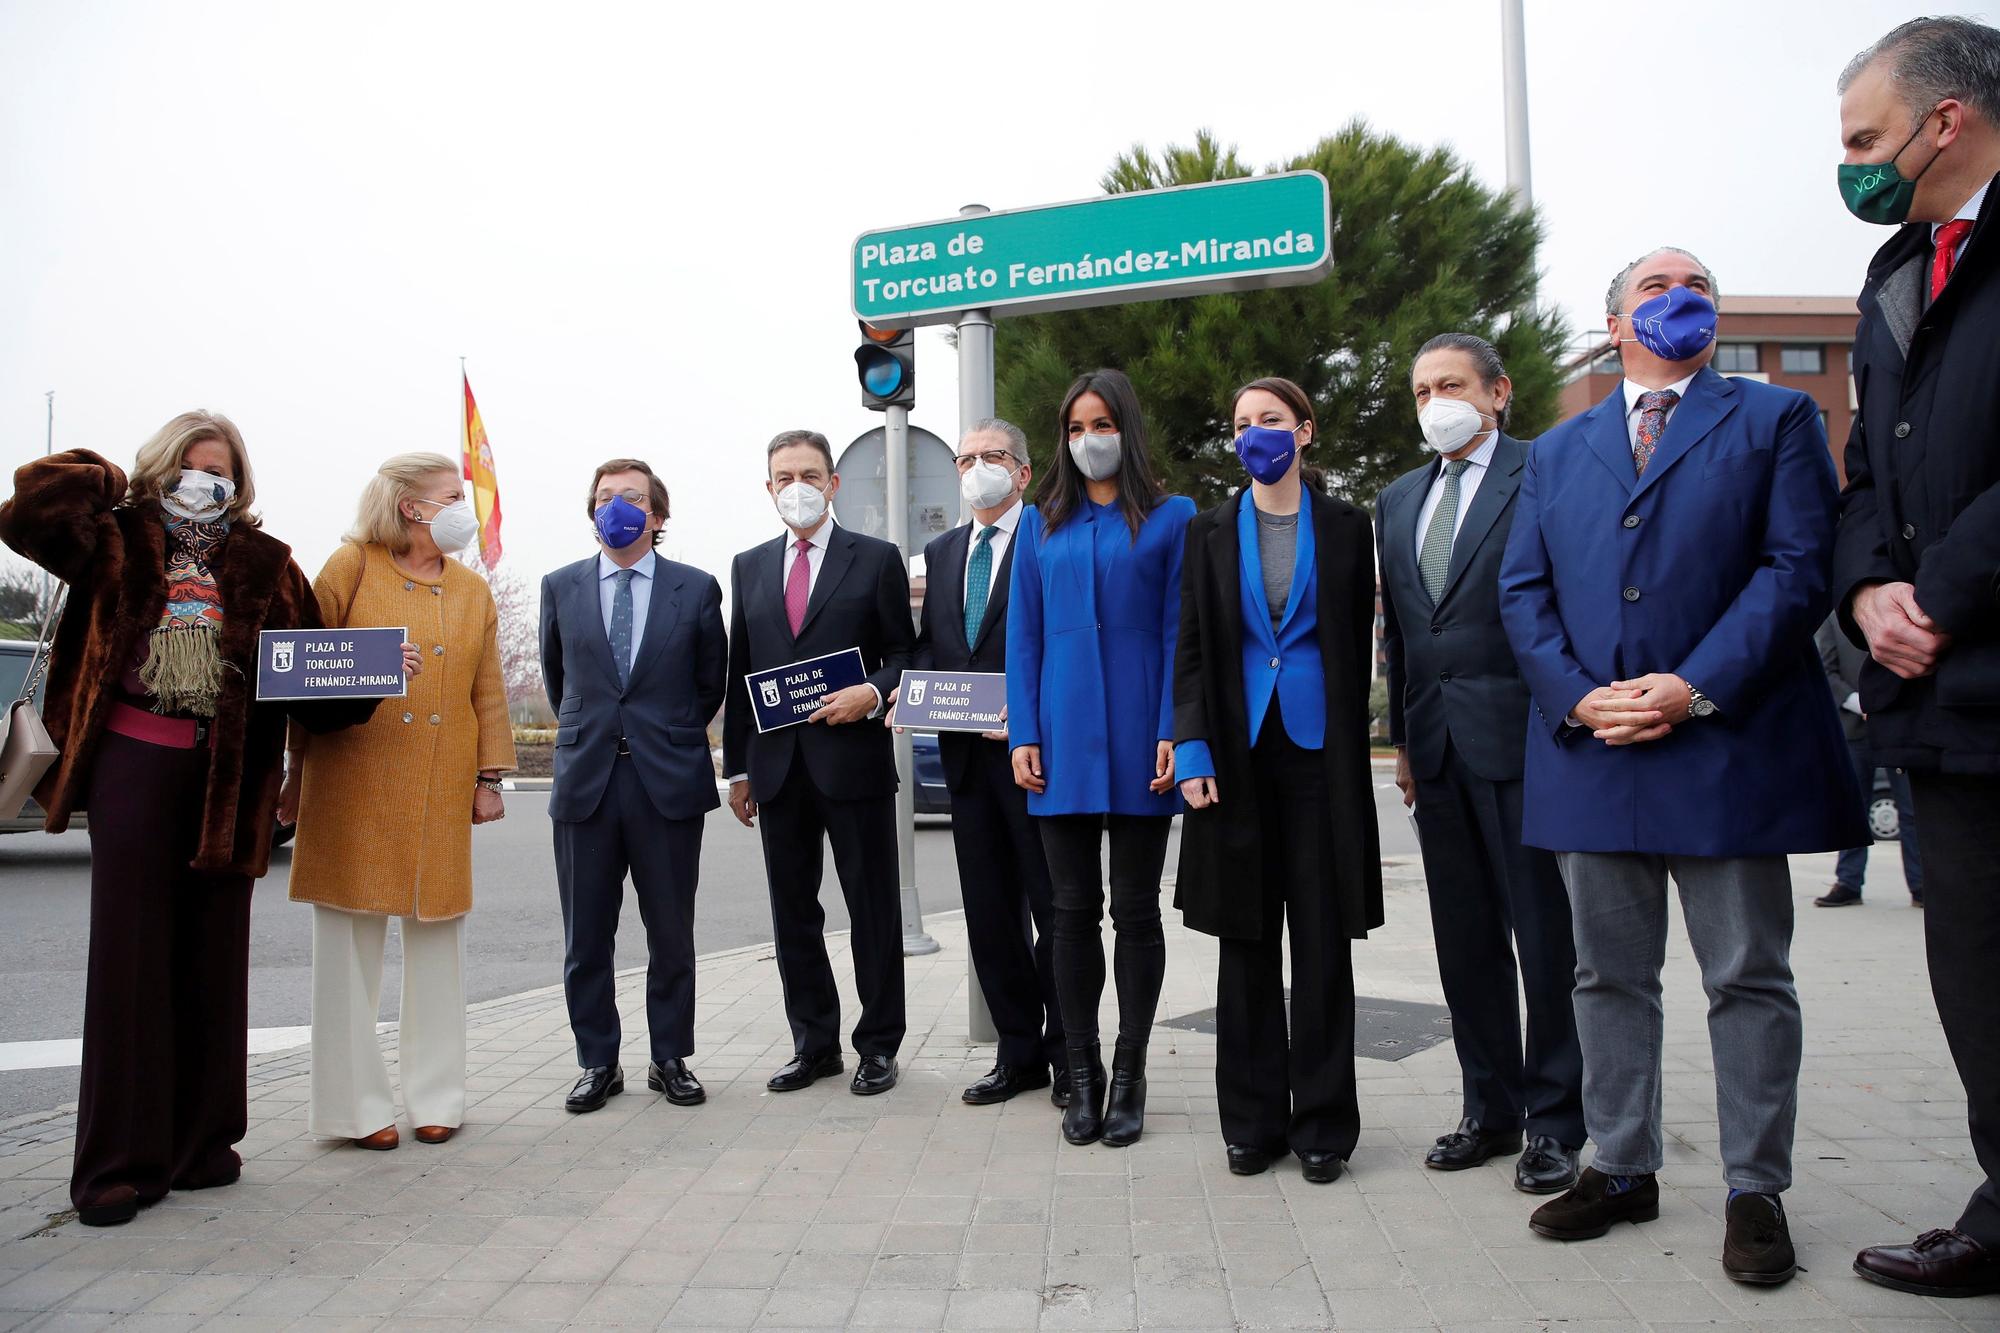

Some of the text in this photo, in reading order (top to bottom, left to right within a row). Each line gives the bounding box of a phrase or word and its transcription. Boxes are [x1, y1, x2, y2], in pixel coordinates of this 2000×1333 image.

[1854, 168, 1887, 193] VOX
[861, 232, 984, 268] Plaza de
[863, 230, 1315, 302] Torcuato Fernández-Miranda
[305, 641, 354, 653] PLAZA DE
[305, 658, 355, 670] TORCUATO
[304, 674, 399, 687] FERNÁNDEZ-MIRANDA
[784, 668, 824, 686] PLAZA DE
[788, 682, 828, 700] TORCUATO
[933, 682, 972, 692] PLAZA DE
[932, 696, 970, 706] TORCUATO
